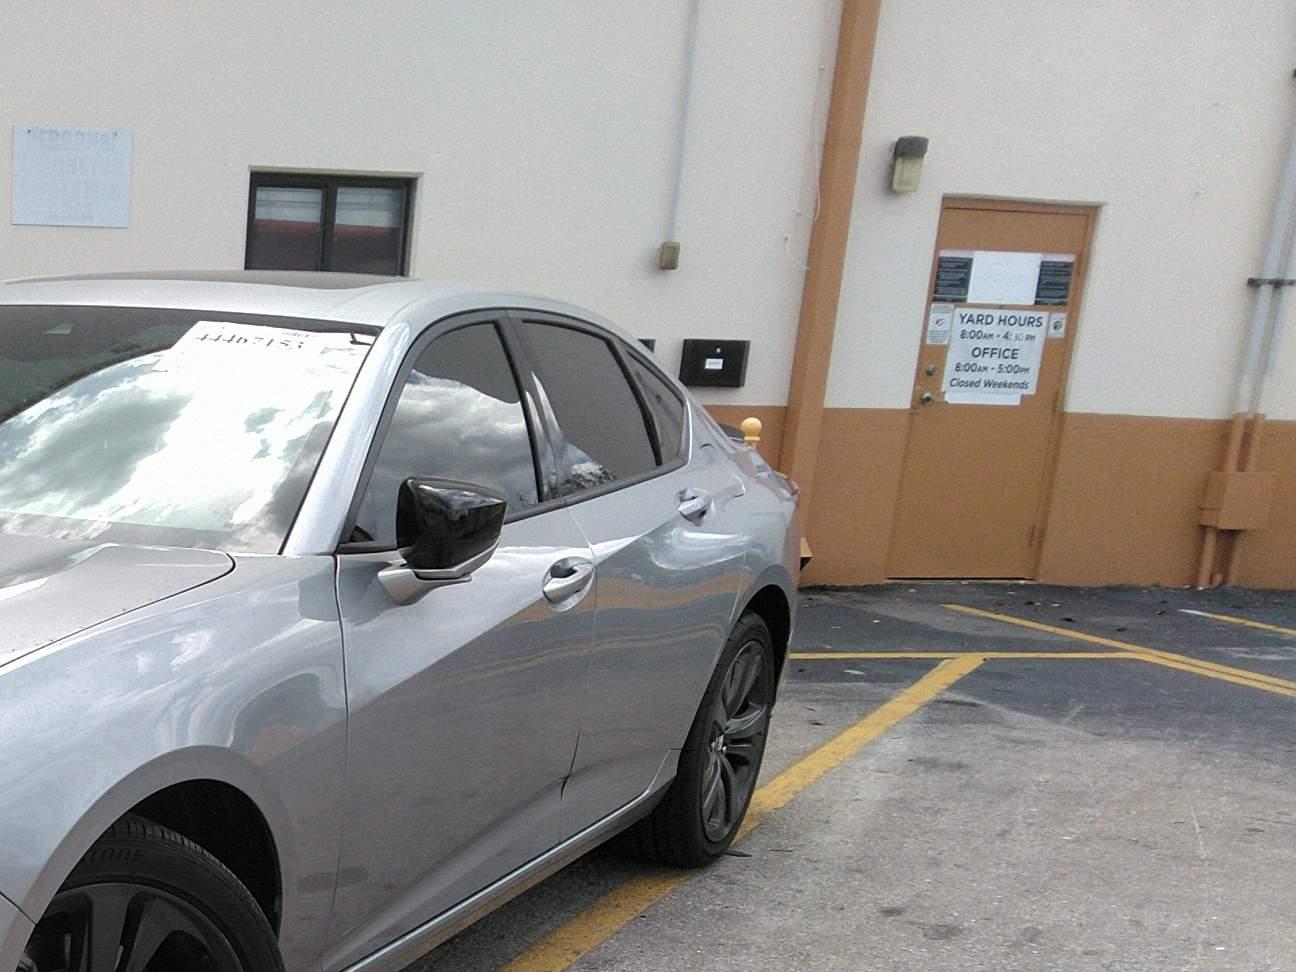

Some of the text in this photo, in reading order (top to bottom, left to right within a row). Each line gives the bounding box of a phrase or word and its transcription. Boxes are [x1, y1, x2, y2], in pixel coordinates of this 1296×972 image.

[959, 313, 1043, 328] YARD HOURS
[971, 346, 1020, 360] OFFICE
[949, 377, 1029, 390] Closed Weekends
